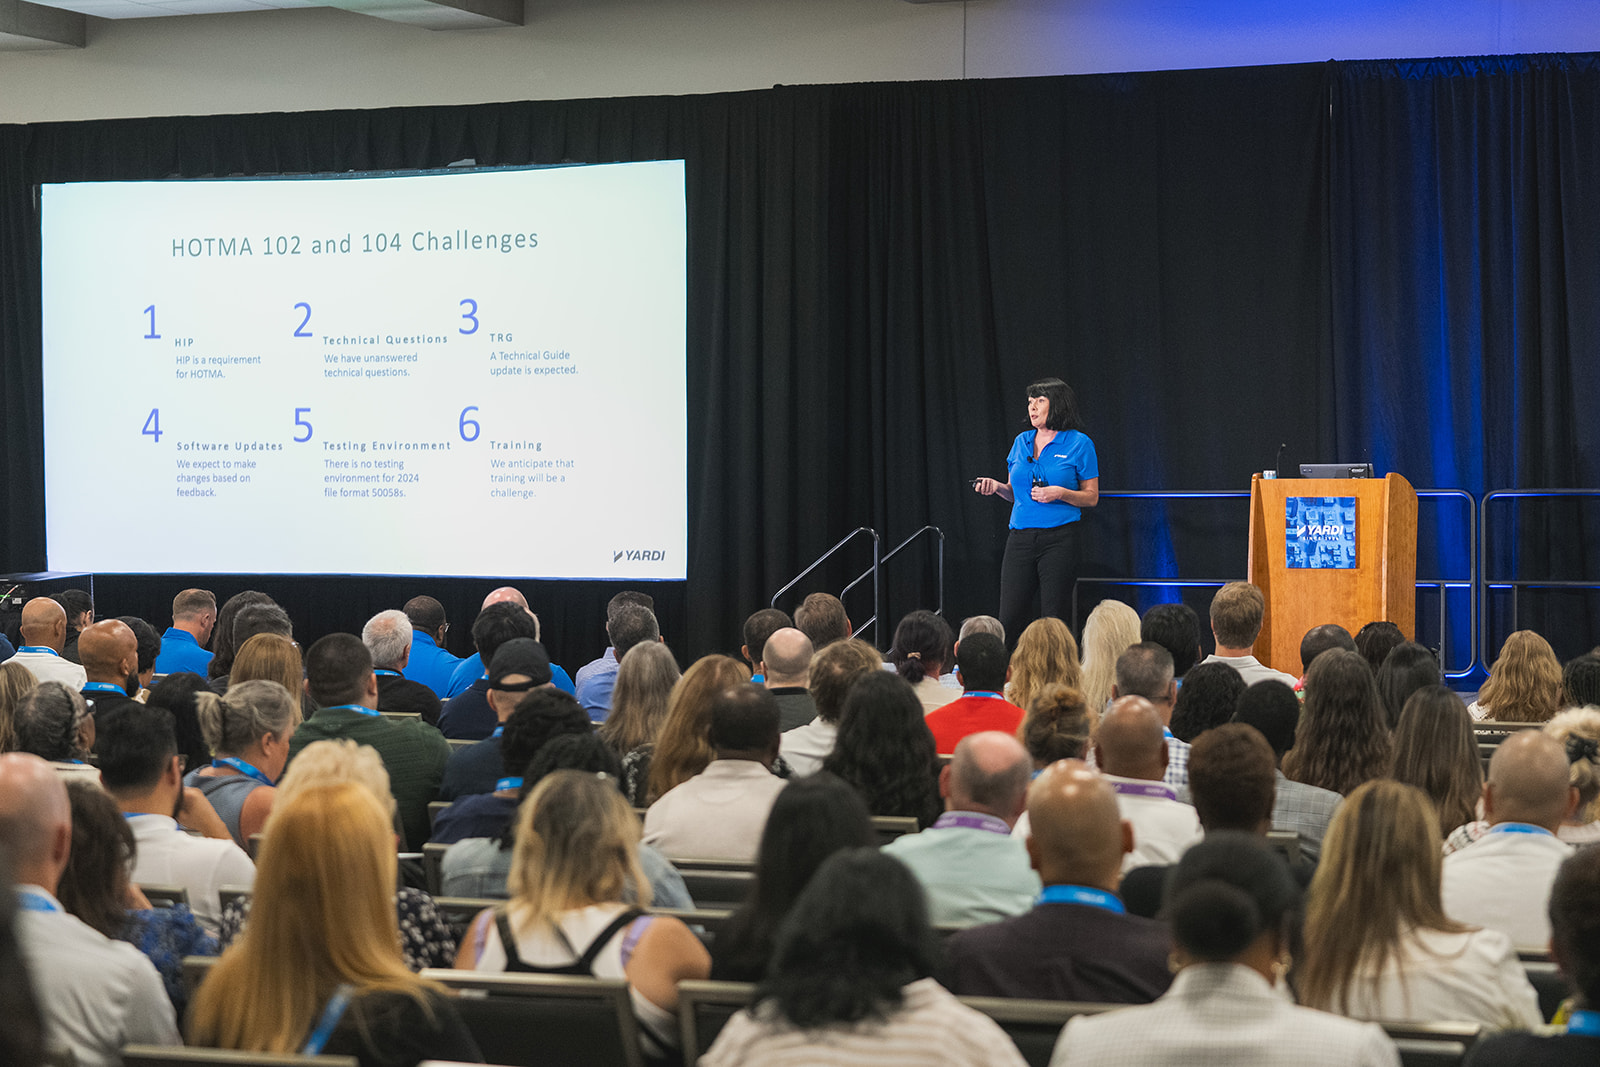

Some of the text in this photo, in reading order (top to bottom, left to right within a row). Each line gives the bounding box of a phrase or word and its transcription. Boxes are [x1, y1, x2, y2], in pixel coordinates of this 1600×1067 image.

[173, 230, 537, 257] HOTMA 102 and 104 Challenges
[144, 305, 161, 339] 1
[294, 302, 313, 337] 2
[459, 299, 479, 335] 3
[174, 338, 194, 347] HIP
[323, 335, 447, 345] Technical Questions
[489, 333, 513, 342] TRG
[175, 356, 191, 364] HIP
[192, 356, 200, 364] is
[209, 355, 261, 366] requirement
[323, 352, 417, 363] We have unanswered
[489, 350, 570, 360] A Technical Guide
[175, 369, 225, 378] for HOTMA.
[324, 368, 410, 378] technical questions.
[491, 366, 522, 376] update
[534, 365, 578, 376] expected.
[142, 408, 163, 443] 4
[294, 408, 313, 442] 5
[459, 406, 480, 442] 6
[177, 441, 282, 452] Software Updates
[323, 441, 450, 452] Testing Environment
[490, 440, 541, 452] Training
[176, 460, 191, 468] We
[193, 461, 220, 469] expect
[234, 460, 256, 468] make
[324, 459, 349, 468] There
[351, 459, 359, 468] is
[374, 459, 404, 470] testing
[490, 459, 574, 469] We anticipate that
[177, 473, 210, 484] changes
[213, 473, 237, 482] based
[324, 473, 419, 482] environment for 2024
[491, 474, 525, 484] training
[528, 474, 543, 482] will
[545, 474, 558, 482] be
[177, 488, 216, 496] feedback.
[325, 488, 406, 497] file format 50058s.
[491, 488, 536, 499] challenge.
[1307, 525, 1344, 535] YARDI
[626, 550, 665, 561] YARDI
